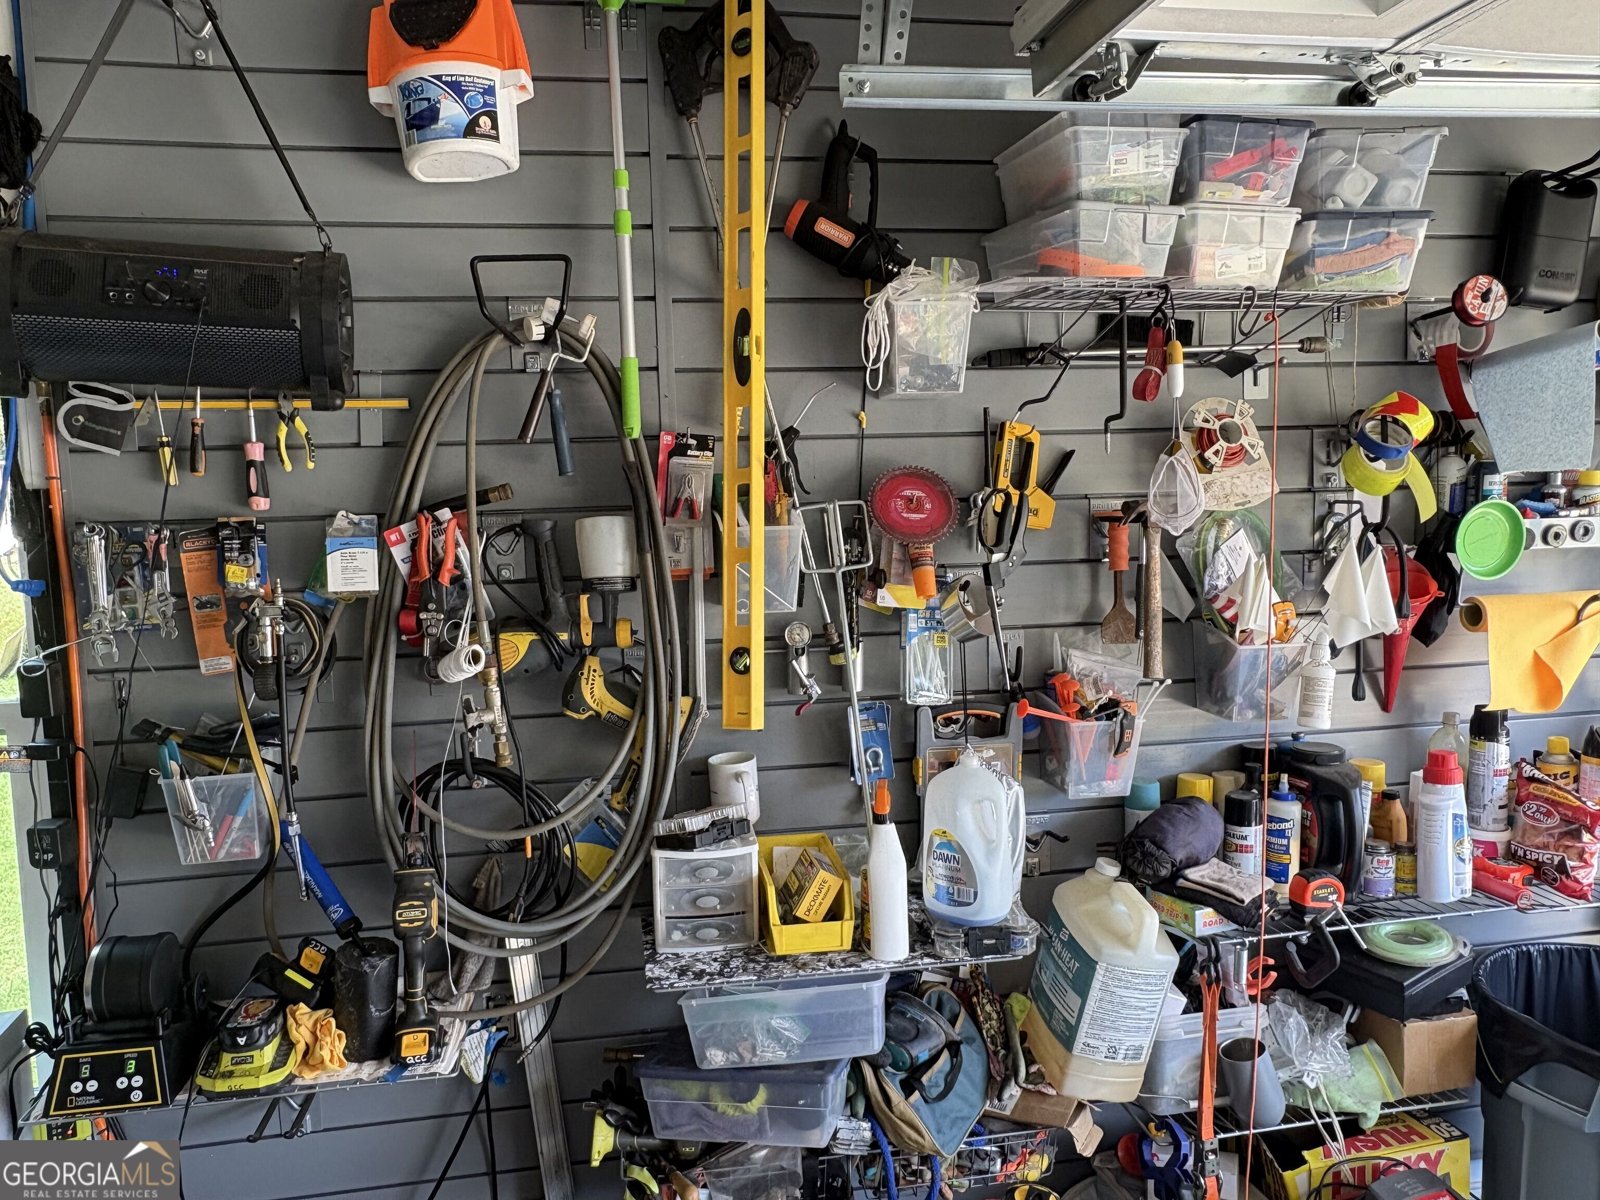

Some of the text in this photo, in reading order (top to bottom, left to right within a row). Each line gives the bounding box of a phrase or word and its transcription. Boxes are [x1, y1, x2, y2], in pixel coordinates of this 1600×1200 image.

[820, 222, 850, 242] WARRIOR
[1468, 275, 1490, 314] CAJUN
[932, 850, 960, 866] DAWN
[1526, 849, 1563, 865] SPICY
[804, 877, 829, 917] DECKMATE
[406, 1054, 428, 1064] QCC
[1430, 1123, 1463, 1138] 50
[1322, 1124, 1430, 1160] HUSKY
